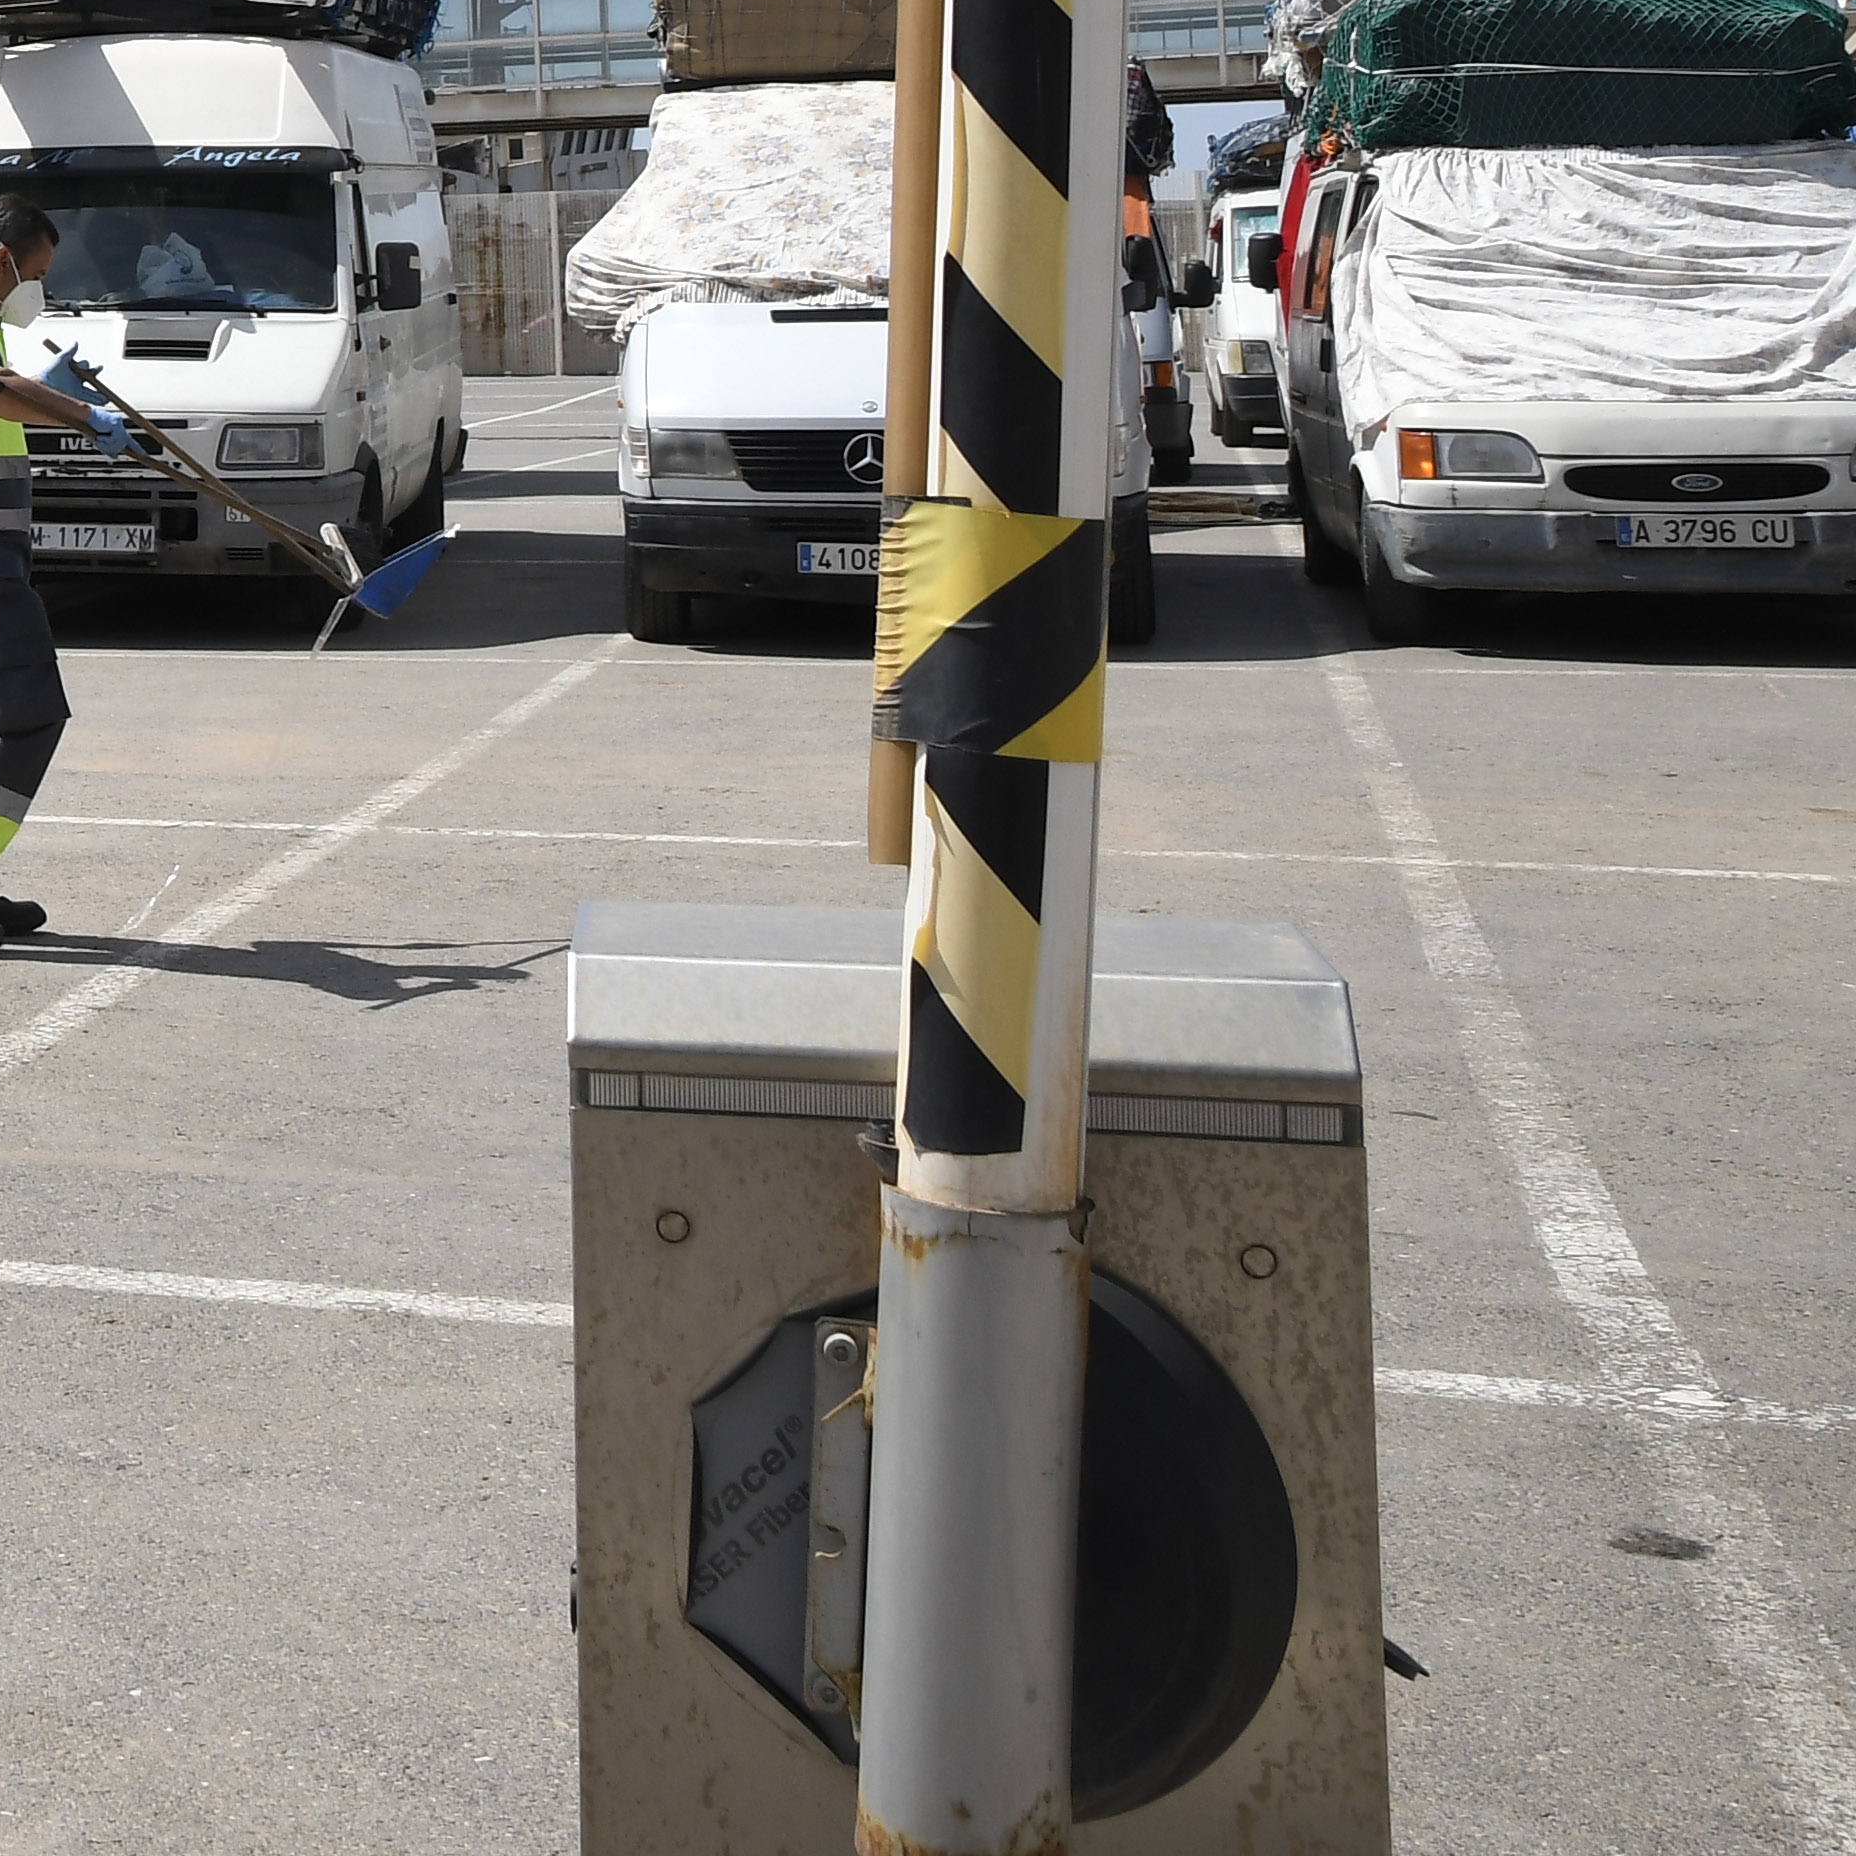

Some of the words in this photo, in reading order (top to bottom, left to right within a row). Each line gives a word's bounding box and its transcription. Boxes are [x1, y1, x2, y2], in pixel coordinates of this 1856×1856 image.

[162, 145, 303, 168] Angela
[1663, 519, 1737, 544] 3796
[1751, 519, 1789, 544] CU
[817, 547, 880, 571] 4108
